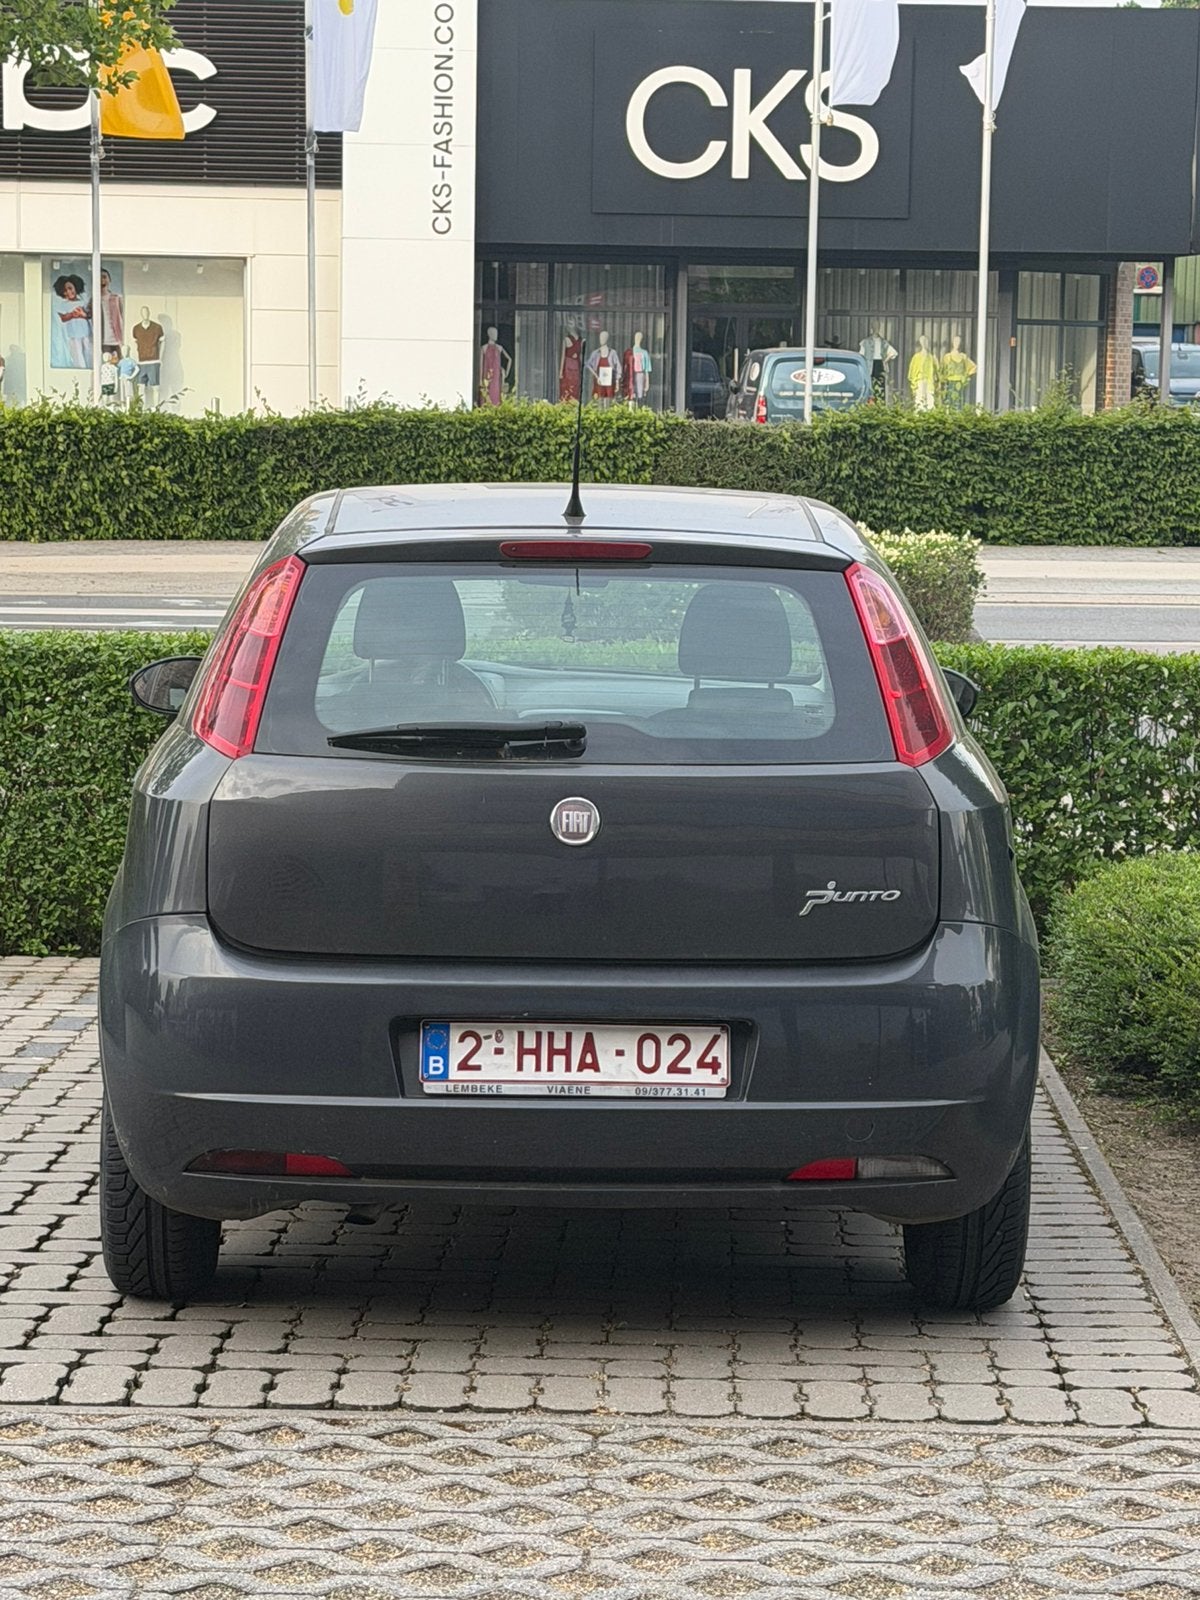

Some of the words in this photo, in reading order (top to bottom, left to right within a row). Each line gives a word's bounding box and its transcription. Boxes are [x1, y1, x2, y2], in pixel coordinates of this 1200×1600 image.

[431, 3, 454, 235] CKS-FASHION.CO
[625, 65, 880, 182] CKS
[562, 811, 590, 833] FIAT
[429, 1056, 444, 1075] B
[445, 1084, 503, 1093] LEMBEKE
[546, 1085, 591, 1095] VIAENE
[635, 1087, 706, 1097] 09/377.31.41
